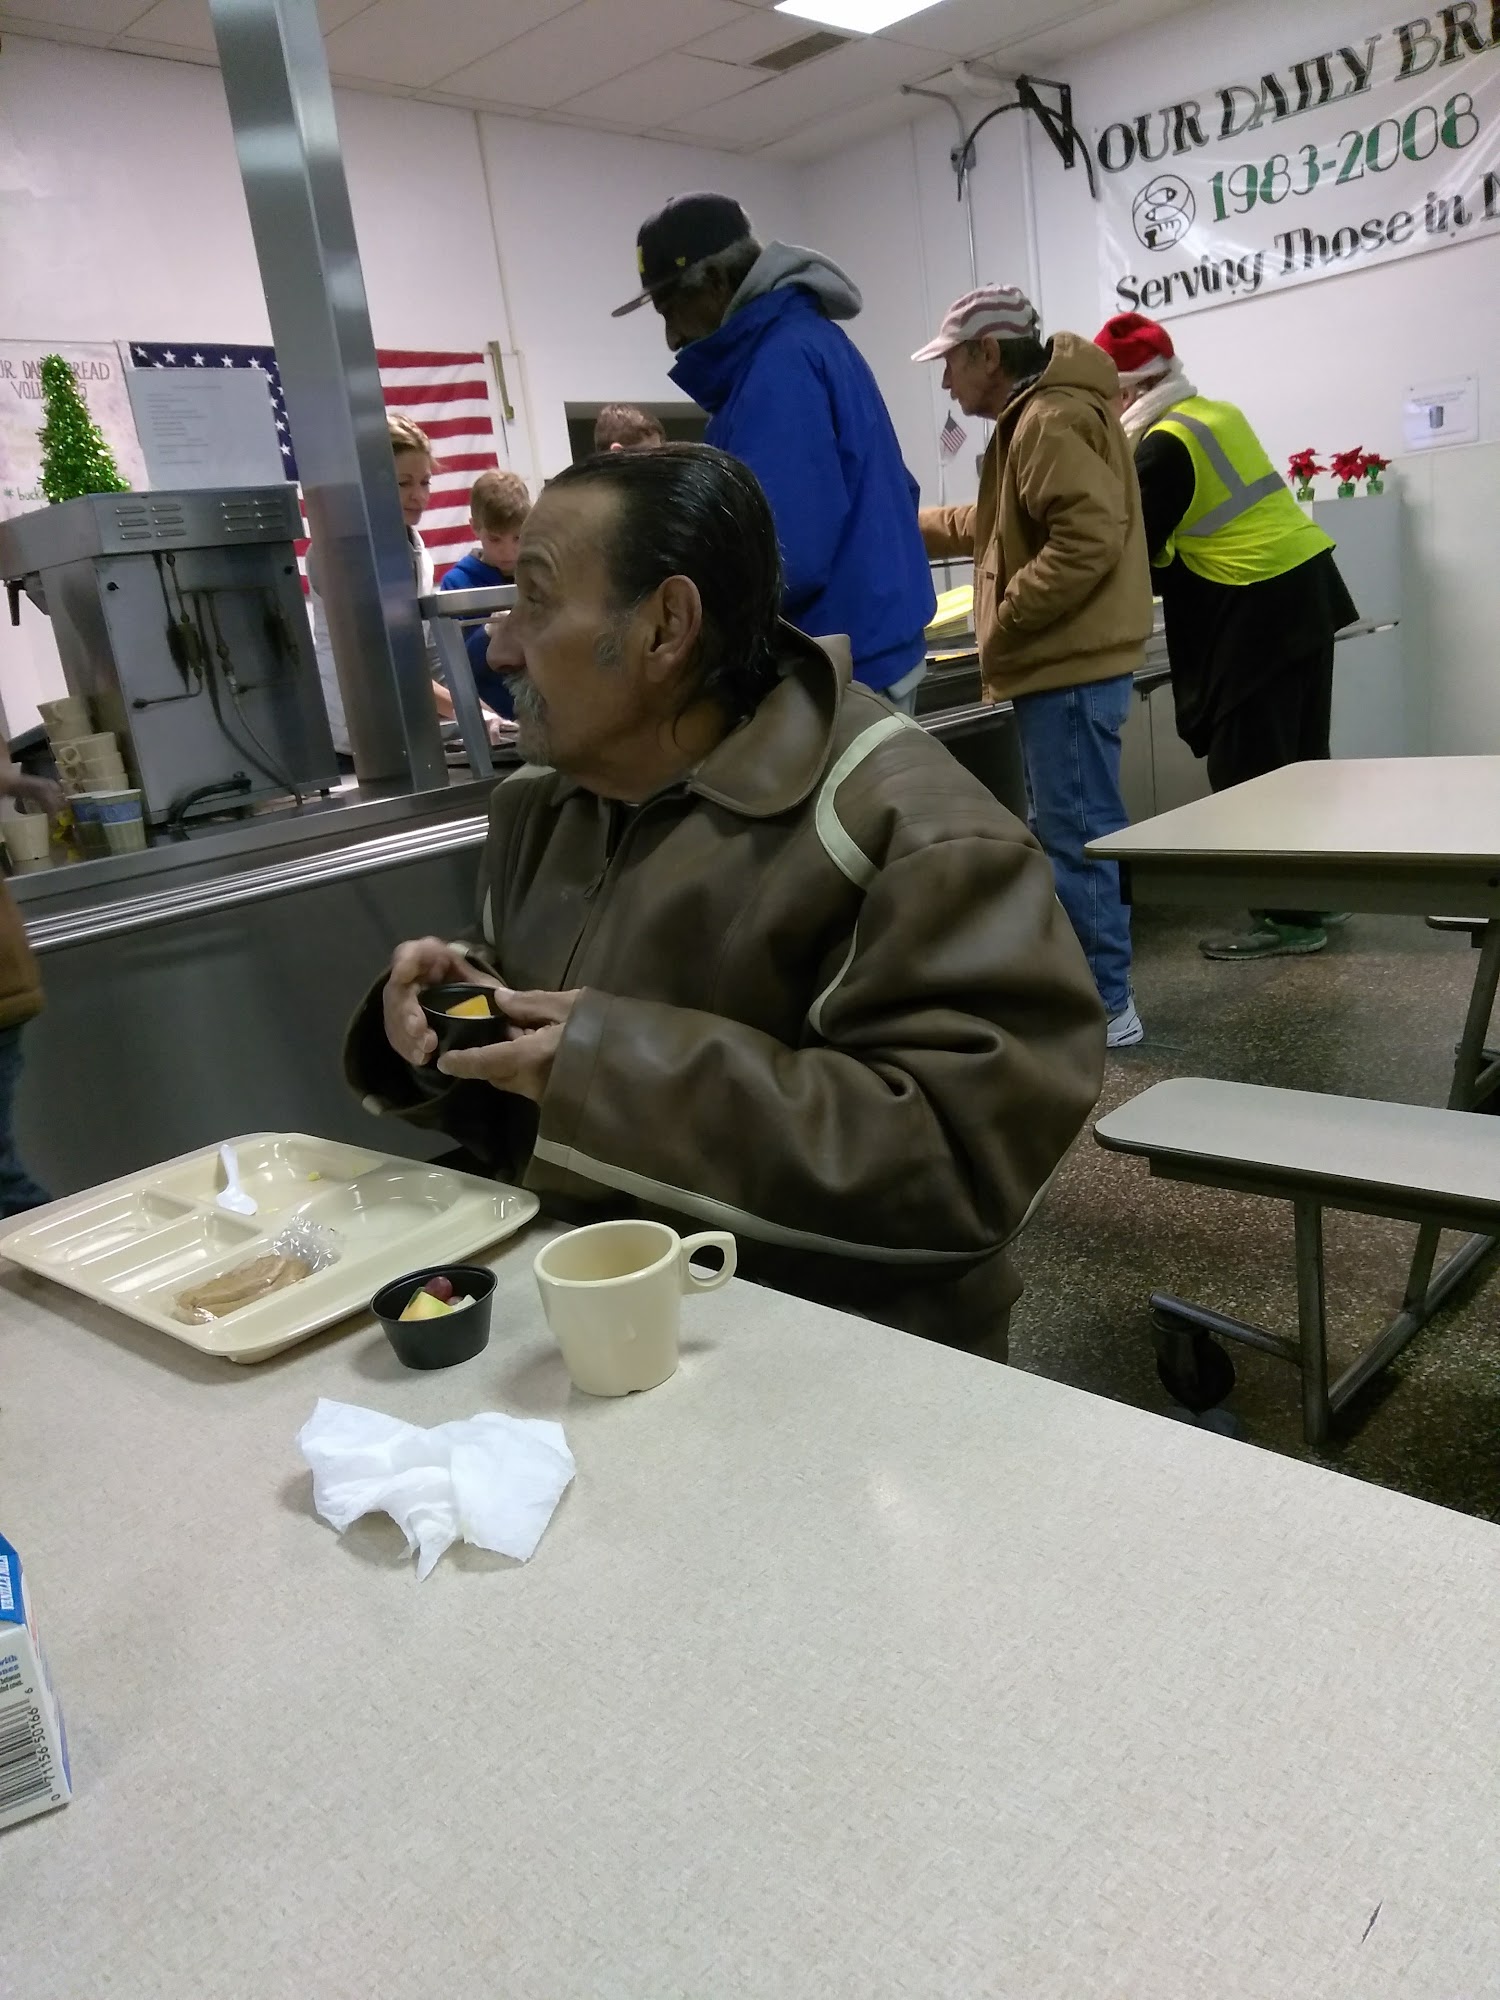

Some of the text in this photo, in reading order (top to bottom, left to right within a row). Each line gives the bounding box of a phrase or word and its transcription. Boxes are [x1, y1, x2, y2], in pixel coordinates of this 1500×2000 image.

[1097, 100, 1209, 173] OUR
[1215, 33, 1382, 141] DAILY
[1207, 92, 1480, 223] 1983-2008
[1116, 249, 1265, 314] Serving
[1273, 209, 1414, 276] Those
[1424, 191, 1473, 236] in
